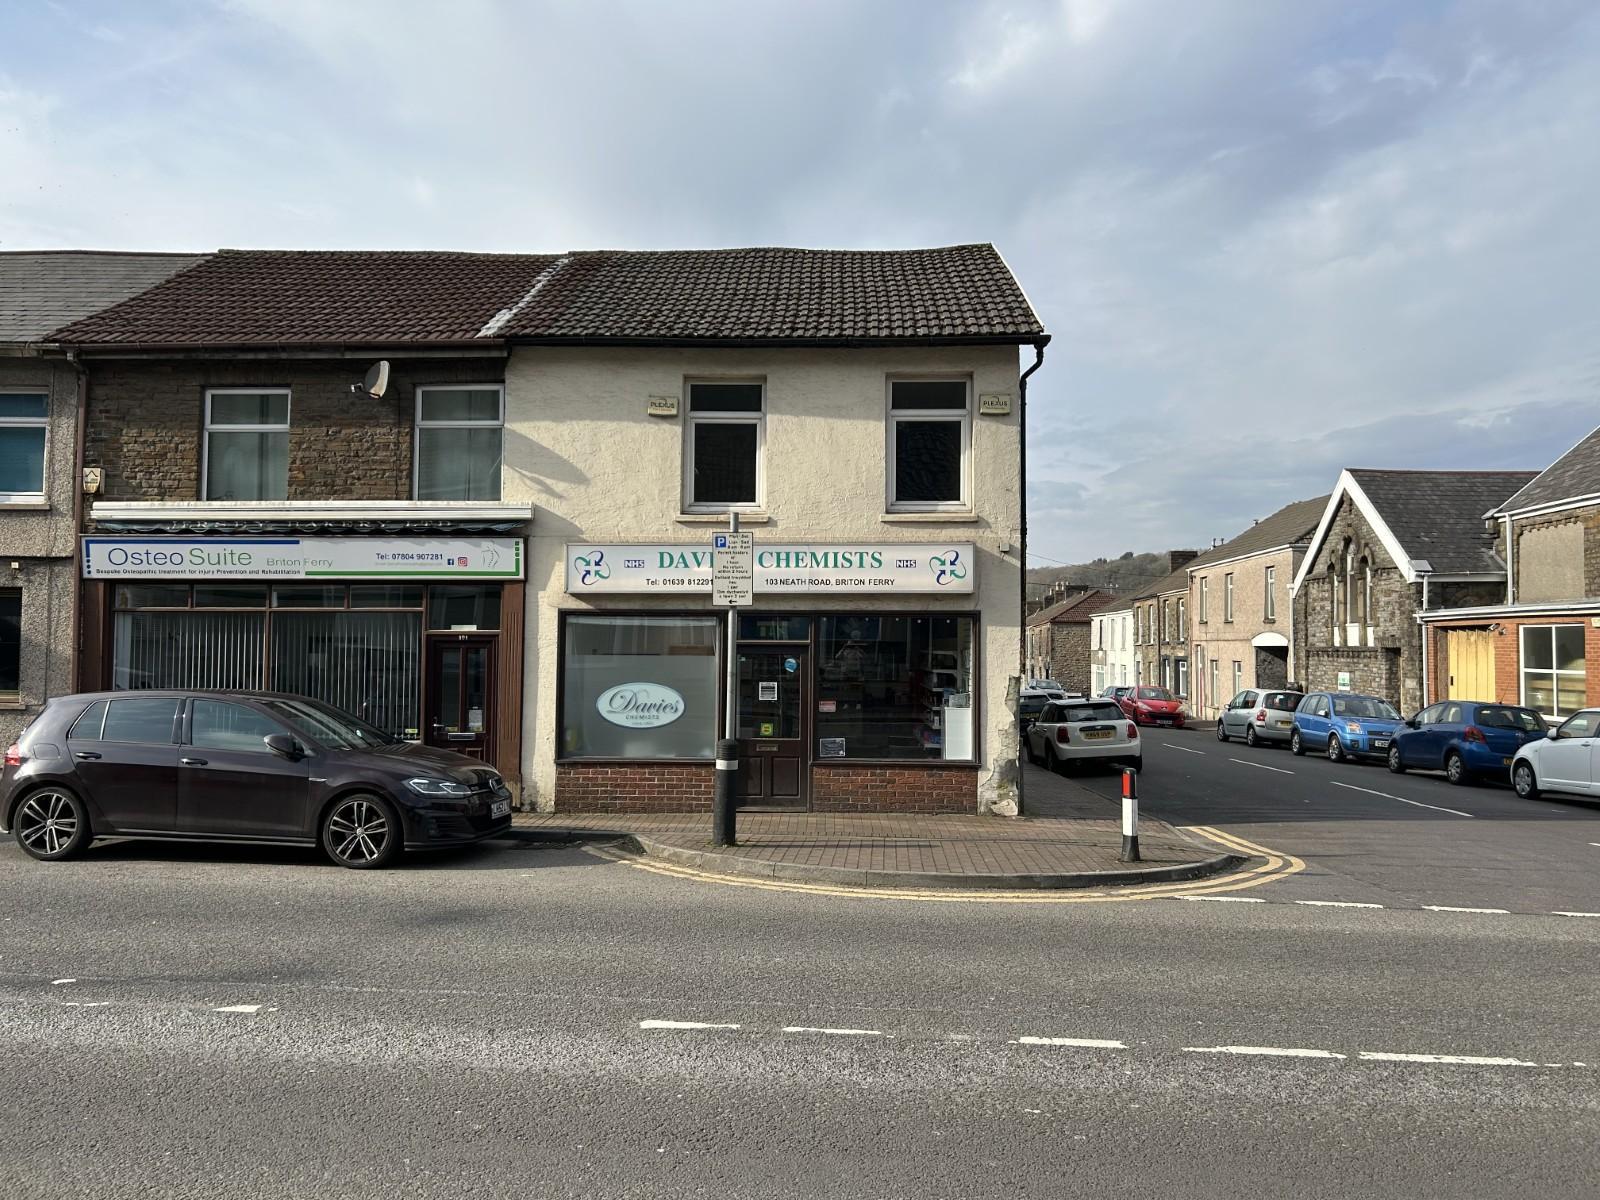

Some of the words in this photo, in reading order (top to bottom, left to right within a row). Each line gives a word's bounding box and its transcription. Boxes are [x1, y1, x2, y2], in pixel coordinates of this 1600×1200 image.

[650, 401, 675, 409] PLEXUS
[717, 537, 725, 547] P
[107, 547, 184, 566] Osteo
[188, 547, 252, 566] Suite
[376, 553, 390, 561] Tel:
[391, 553, 415, 561] 07804
[416, 553, 444, 561] 907281
[624, 560, 645, 568] NHS
[757, 550, 884, 569] CHEMISTS
[896, 560, 917, 568] NHS
[266, 557, 301, 567] Briton
[303, 558, 334, 568] Ferry
[764, 578, 779, 586] 103
[779, 578, 808, 586] NEATH
[835, 578, 866, 586] BRITON
[868, 578, 895, 586] FERRY
[605, 688, 681, 714] Davies
